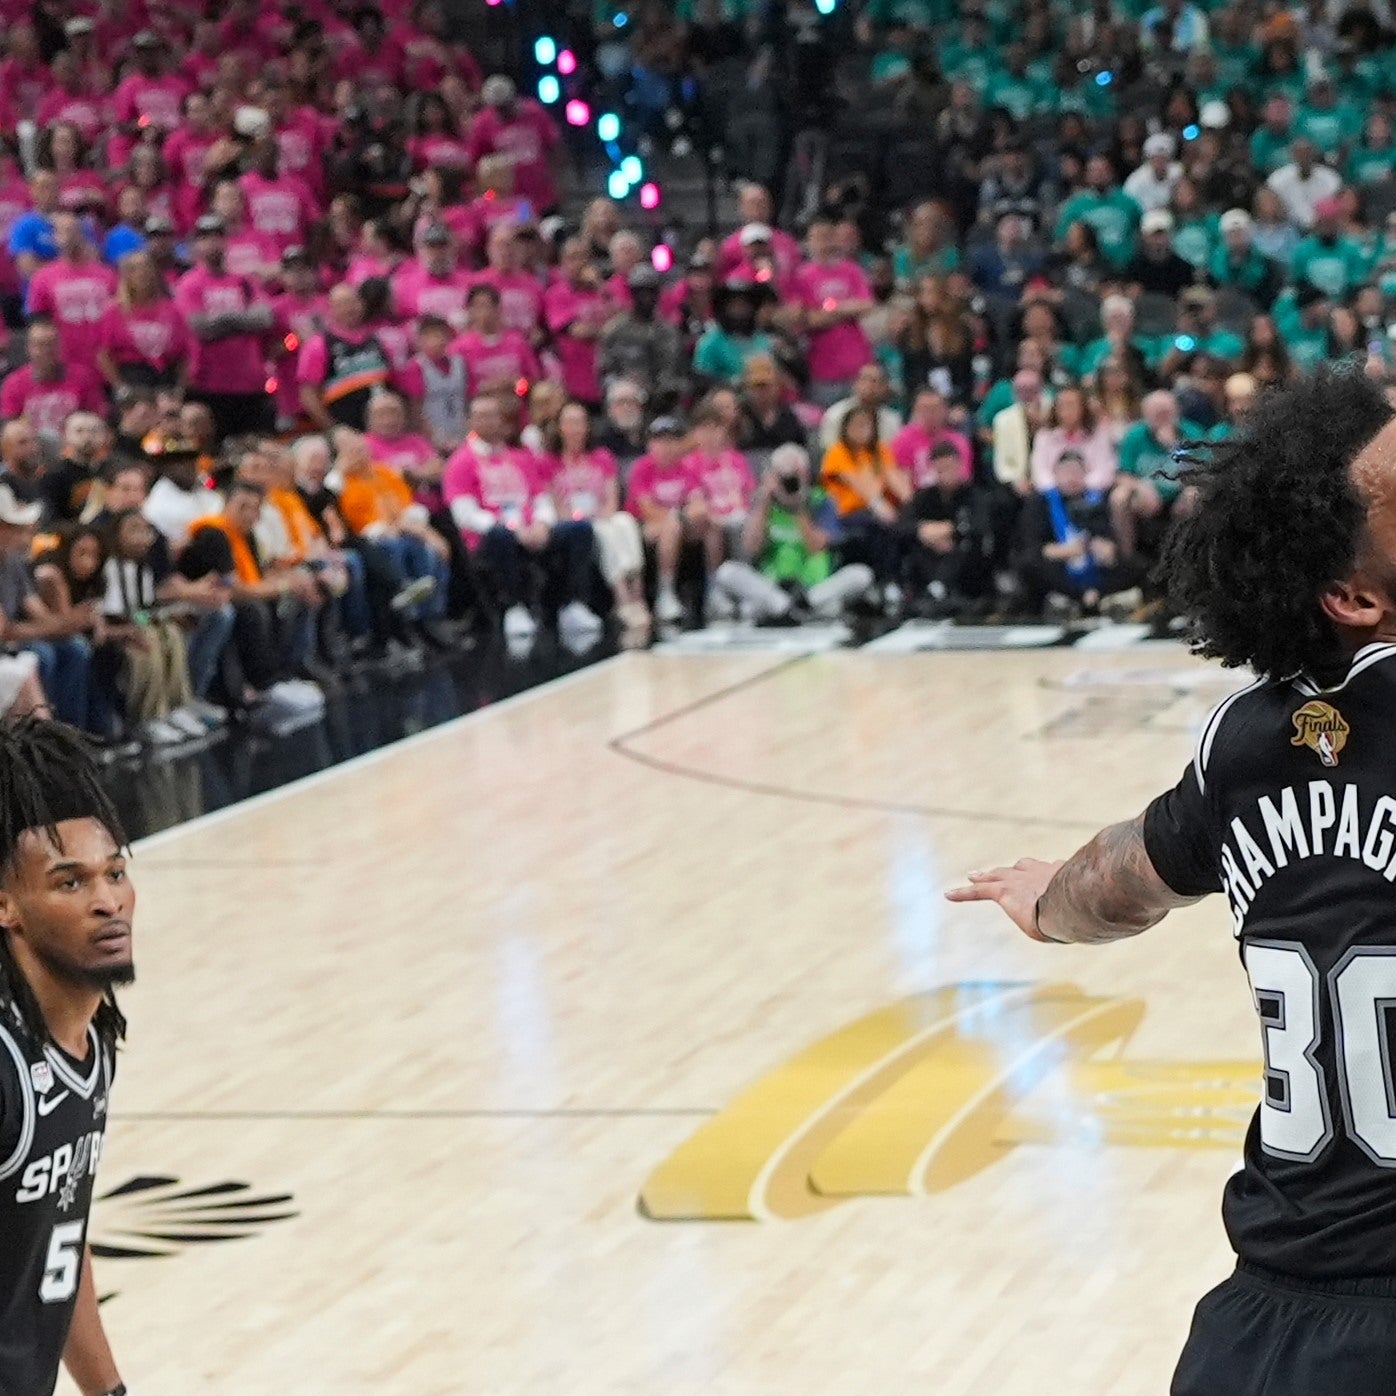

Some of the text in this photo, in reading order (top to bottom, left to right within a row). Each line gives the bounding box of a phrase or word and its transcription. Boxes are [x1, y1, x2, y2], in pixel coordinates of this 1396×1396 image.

[1293, 711, 1348, 744] Finals
[16, 1130, 102, 1204] SPUR
[38, 1218, 85, 1304] 5
